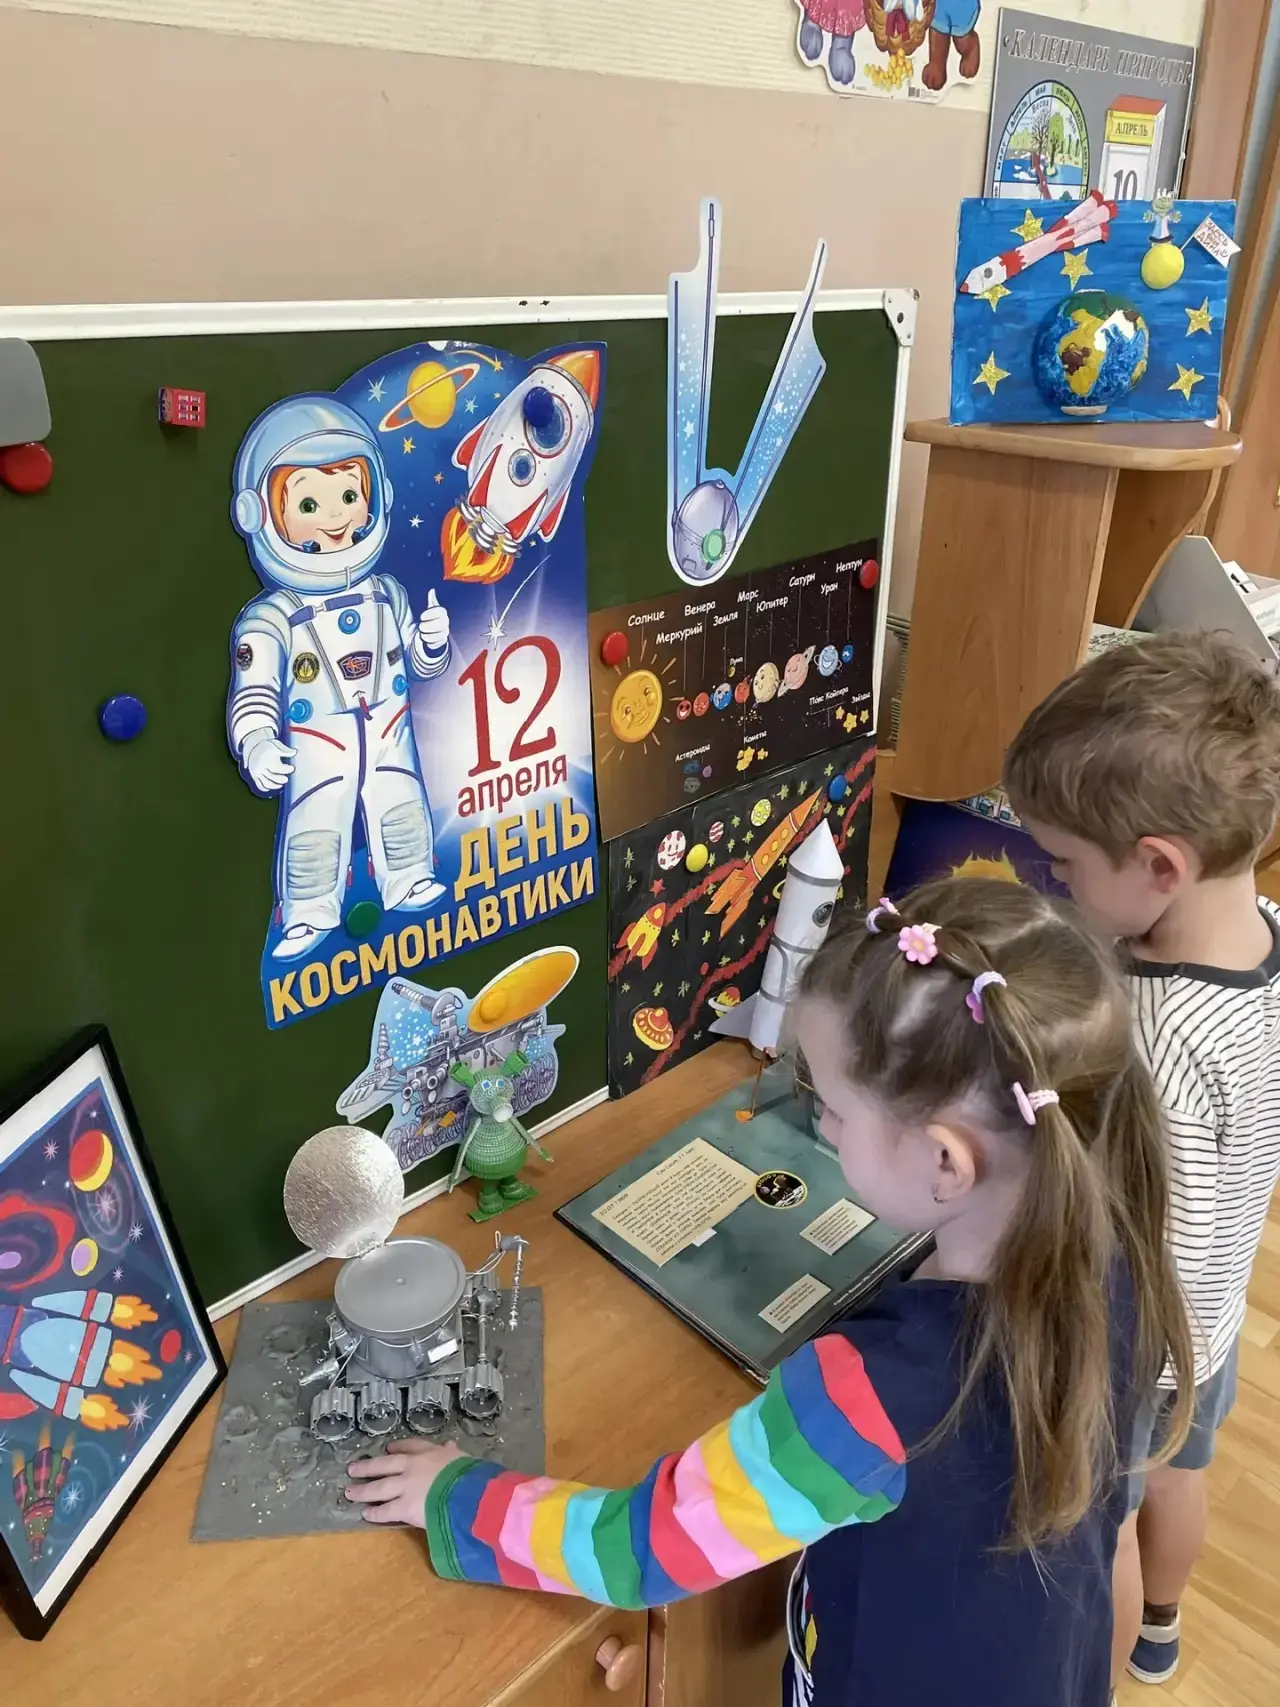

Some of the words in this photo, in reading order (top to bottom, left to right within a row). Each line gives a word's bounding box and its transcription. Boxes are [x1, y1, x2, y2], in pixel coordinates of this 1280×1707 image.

[1009, 29, 1110, 73] КАЛЕНДАРЬ
[1113, 50, 1192, 86] ПРИРОДЫ
[1036, 85, 1046, 96] МАЙ
[1010, 101, 1028, 127] АПРЕЛЬ
[1115, 122, 1148, 136] АПРЕЛЬ
[997, 142, 1006, 170] МАРТ
[1114, 169, 1138, 200] 10
[836, 559, 862, 573] Нептун
[789, 573, 815, 587] Сатурн
[737, 590, 759, 602] Марс
[821, 582, 838, 596] Уран
[684, 600, 716, 616] Венера
[756, 596, 788, 612] Юпитер
[628, 610, 665, 626] Солнце
[712, 611, 738, 626] Земля
[656, 622, 703, 644] Меркурий
[458, 635, 561, 777] 12
[744, 730, 767, 744] Кометы
[675, 744, 711, 762] Астероиды
[458, 754, 568, 817] апреля
[453, 797, 591, 902] ДЕНЬ
[269, 857, 595, 1023] КОСМОНАВТИКИ
